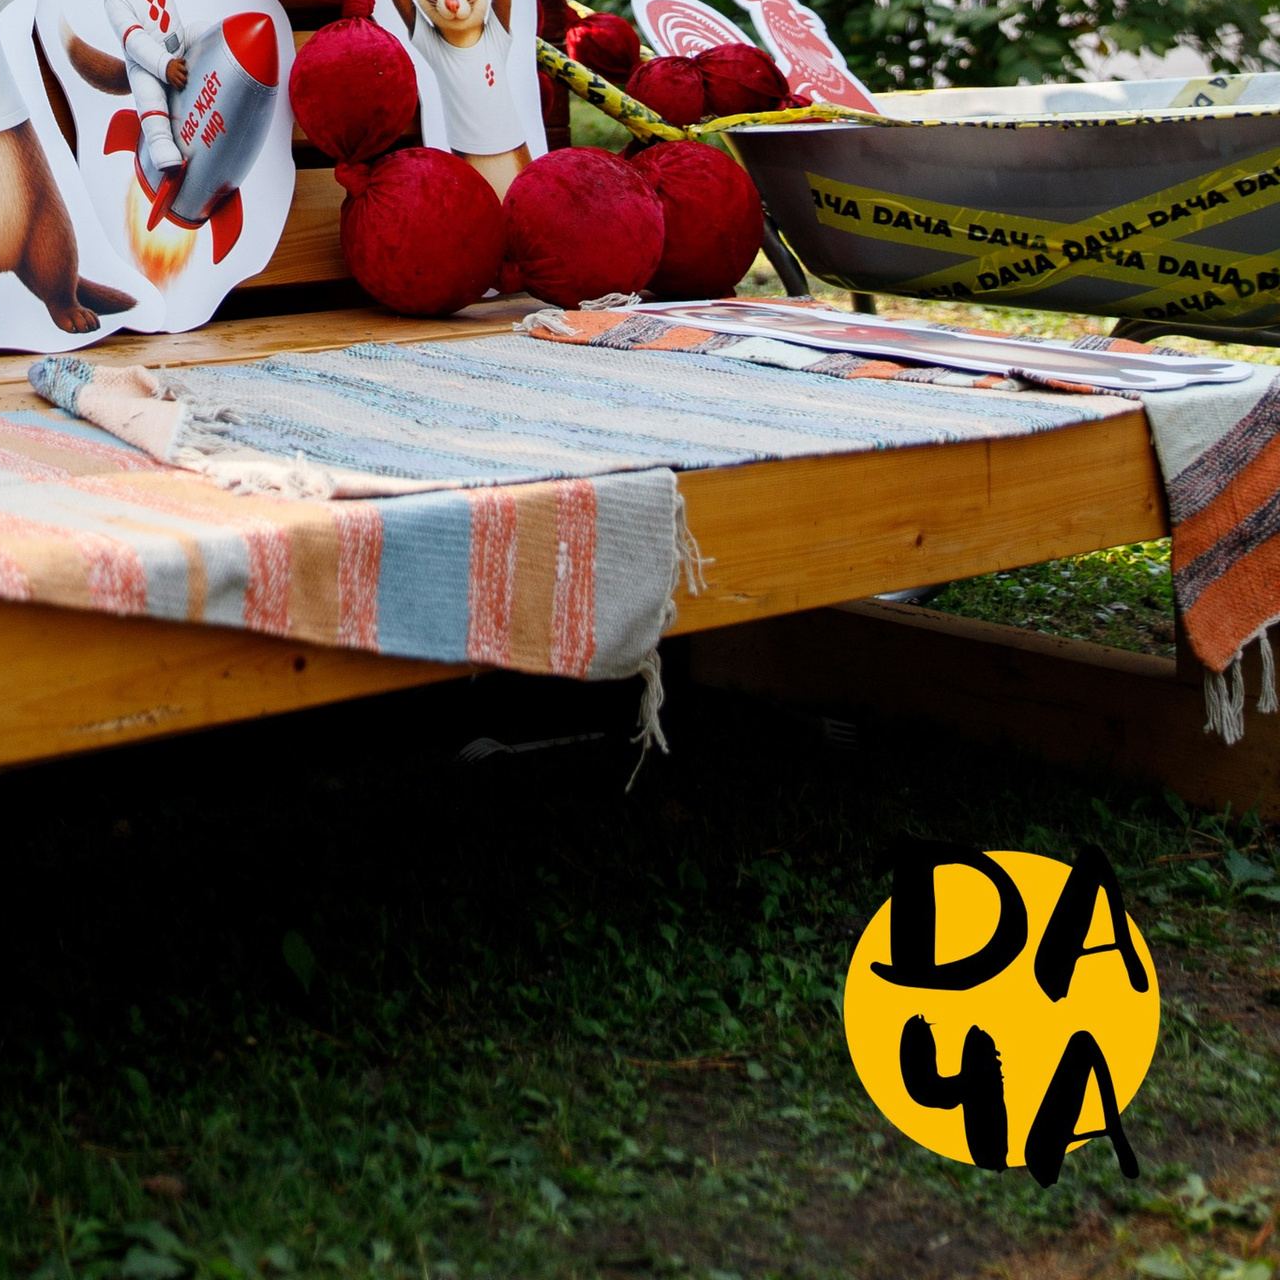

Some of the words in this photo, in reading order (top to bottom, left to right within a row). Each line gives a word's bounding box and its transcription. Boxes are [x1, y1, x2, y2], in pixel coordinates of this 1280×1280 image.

[180, 111, 199, 146] нас
[193, 70, 221, 119] ждёт
[201, 110, 226, 149] мир
